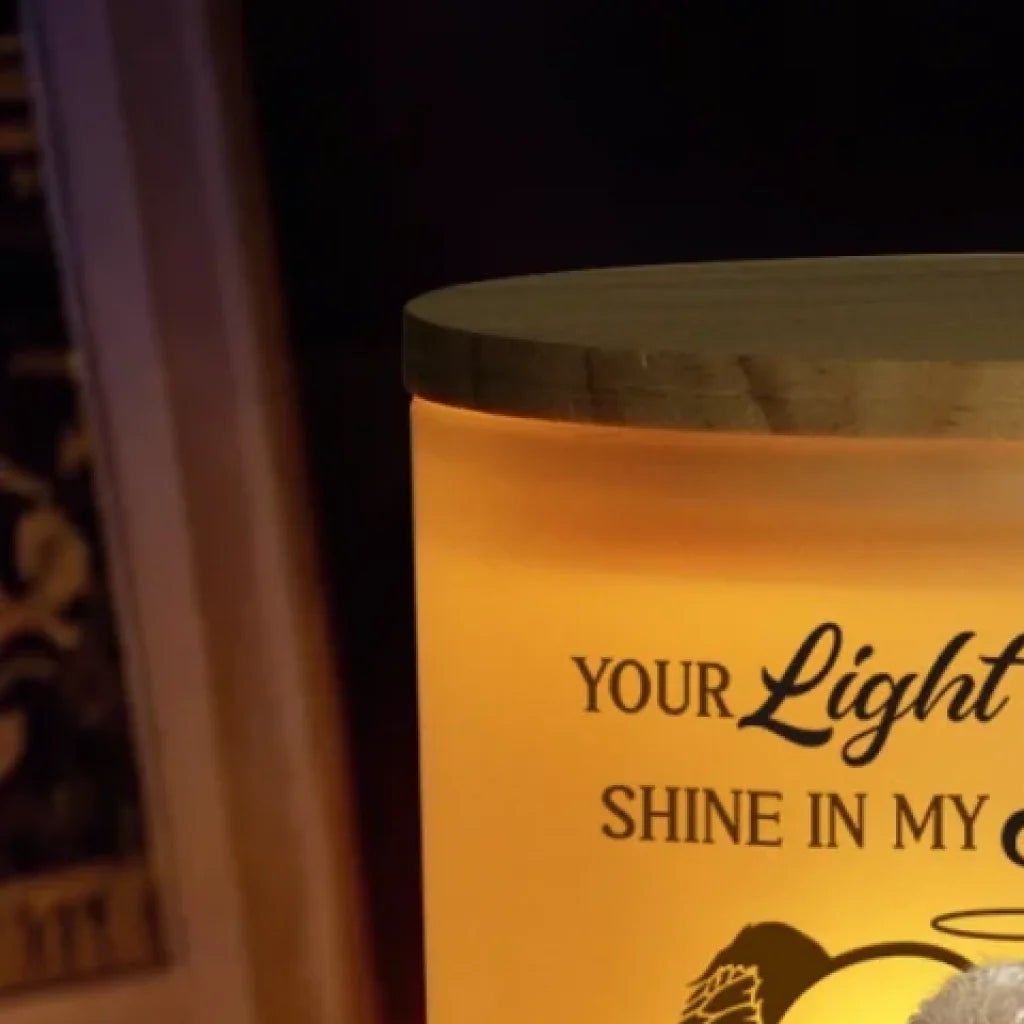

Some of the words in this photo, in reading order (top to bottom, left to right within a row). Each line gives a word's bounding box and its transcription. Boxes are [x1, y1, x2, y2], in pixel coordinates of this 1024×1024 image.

[571, 657, 732, 718] YOUR
[600, 784, 784, 848] SHINE
[807, 793, 867, 849] IN
[893, 794, 990, 851] MY
